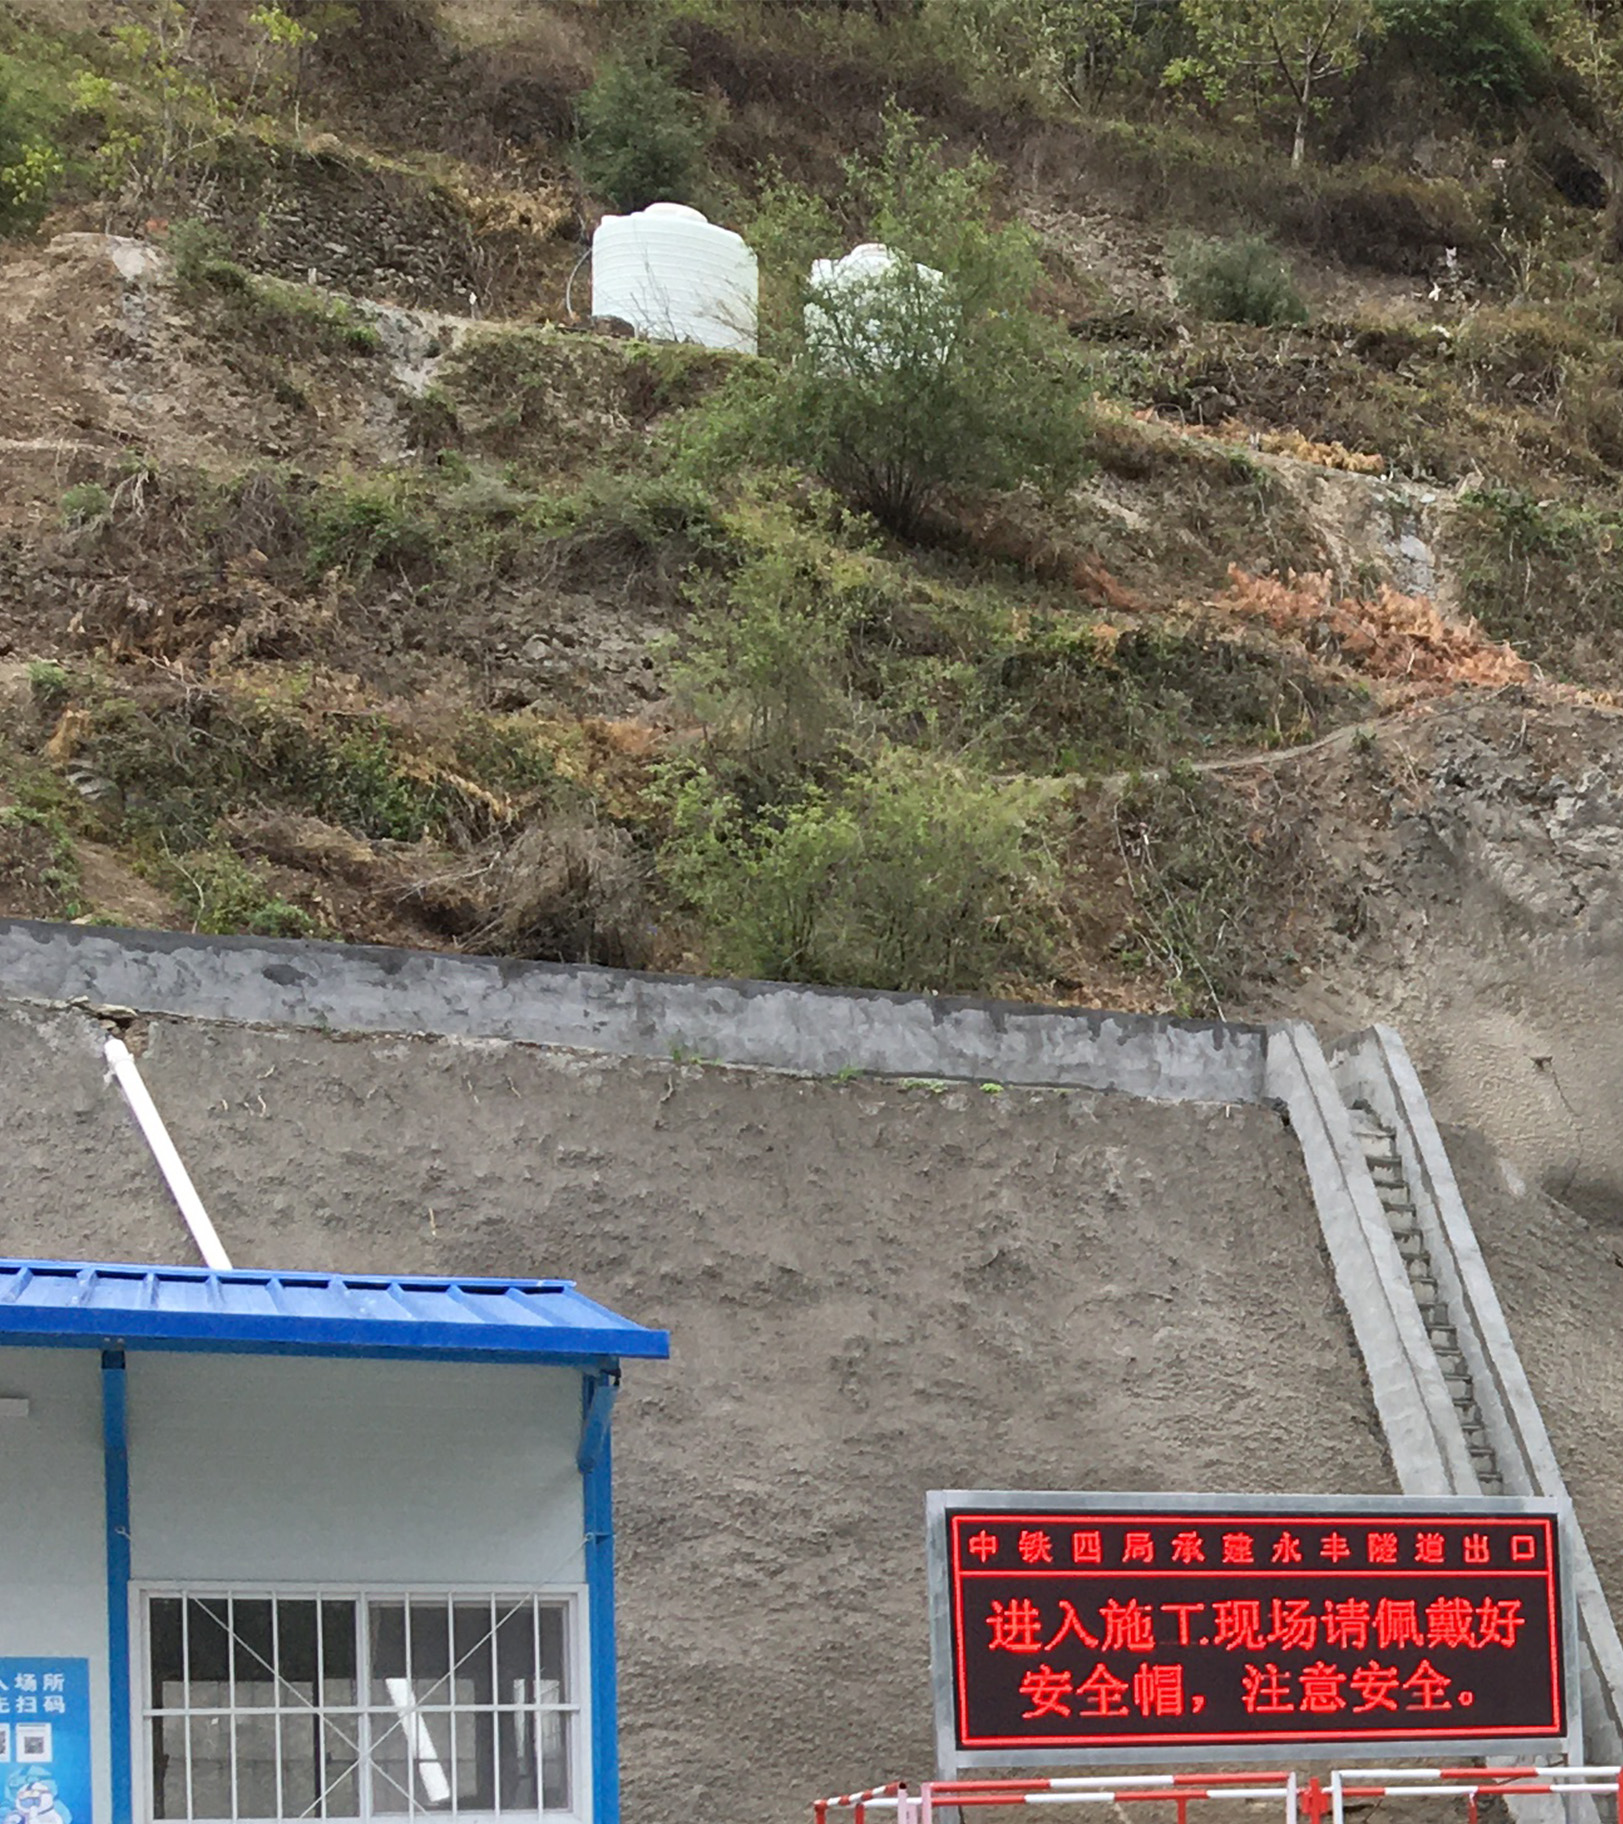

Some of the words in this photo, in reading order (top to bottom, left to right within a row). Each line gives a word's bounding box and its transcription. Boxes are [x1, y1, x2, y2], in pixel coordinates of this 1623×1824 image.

[968, 1530, 1536, 1564] 中铁四局承建永丰隧道出口
[987, 1597, 1524, 1652] 进入施工现场请佩戴好
[1019, 1660, 1474, 1718] 安全帽，注意安全。
